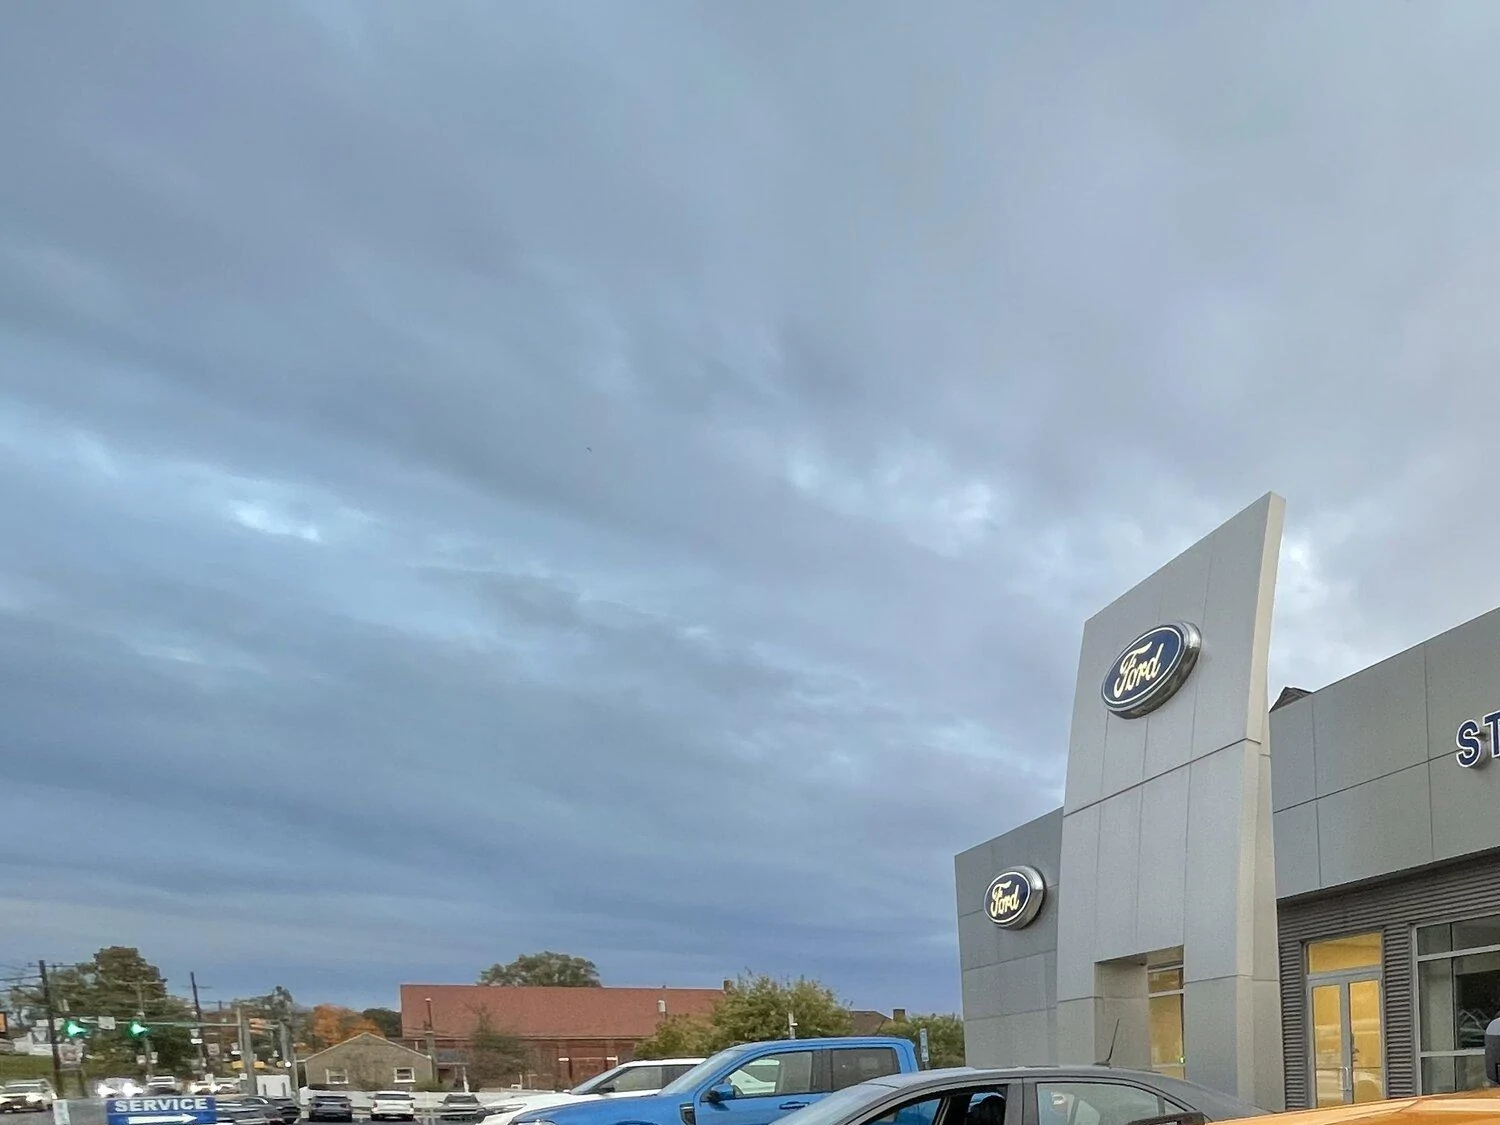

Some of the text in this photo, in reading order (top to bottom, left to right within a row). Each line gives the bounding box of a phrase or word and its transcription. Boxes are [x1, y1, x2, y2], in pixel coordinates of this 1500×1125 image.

[1113, 641, 1165, 699] Ford
[990, 880, 1020, 918] Ford
[114, 1098, 209, 1112] SERVICE
